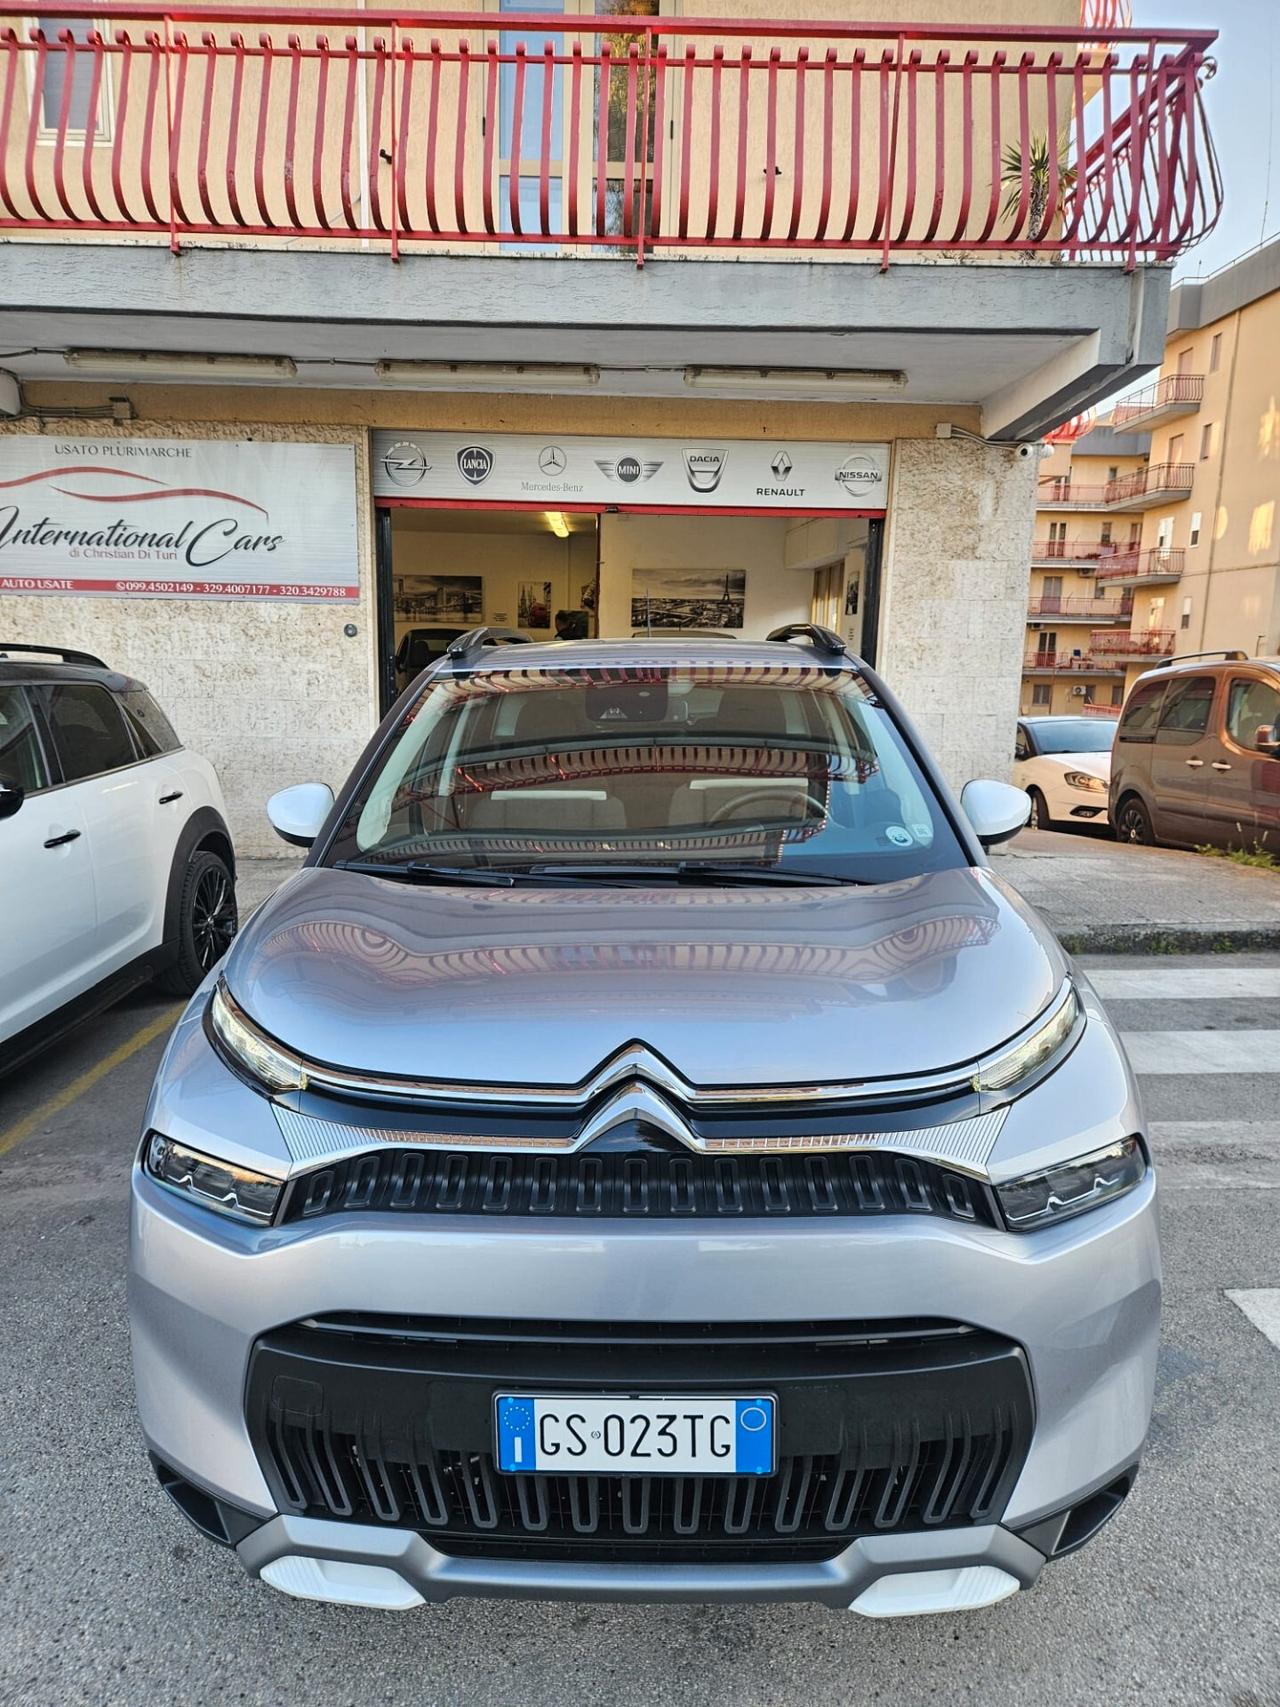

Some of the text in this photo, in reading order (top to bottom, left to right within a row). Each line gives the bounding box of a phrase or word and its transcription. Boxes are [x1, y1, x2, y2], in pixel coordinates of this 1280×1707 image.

[54, 443, 193, 459] USATO PLURIMARCHE
[463, 458, 488, 470] LANCIA
[689, 455, 720, 463] DACIA
[618, 465, 640, 475] MINI
[838, 470, 878, 480] NISSAN
[520, 481, 584, 493] Mercedes-Benz
[756, 487, 806, 497] RENAULT
[0, 505, 285, 567] International Cars
[69, 548, 178, 561] di Christian Di Turi
[0, 578, 75, 590] AUTO USATE
[203, 583, 270, 594] 329.4007177
[279, 585, 346, 597] 320.3429788
